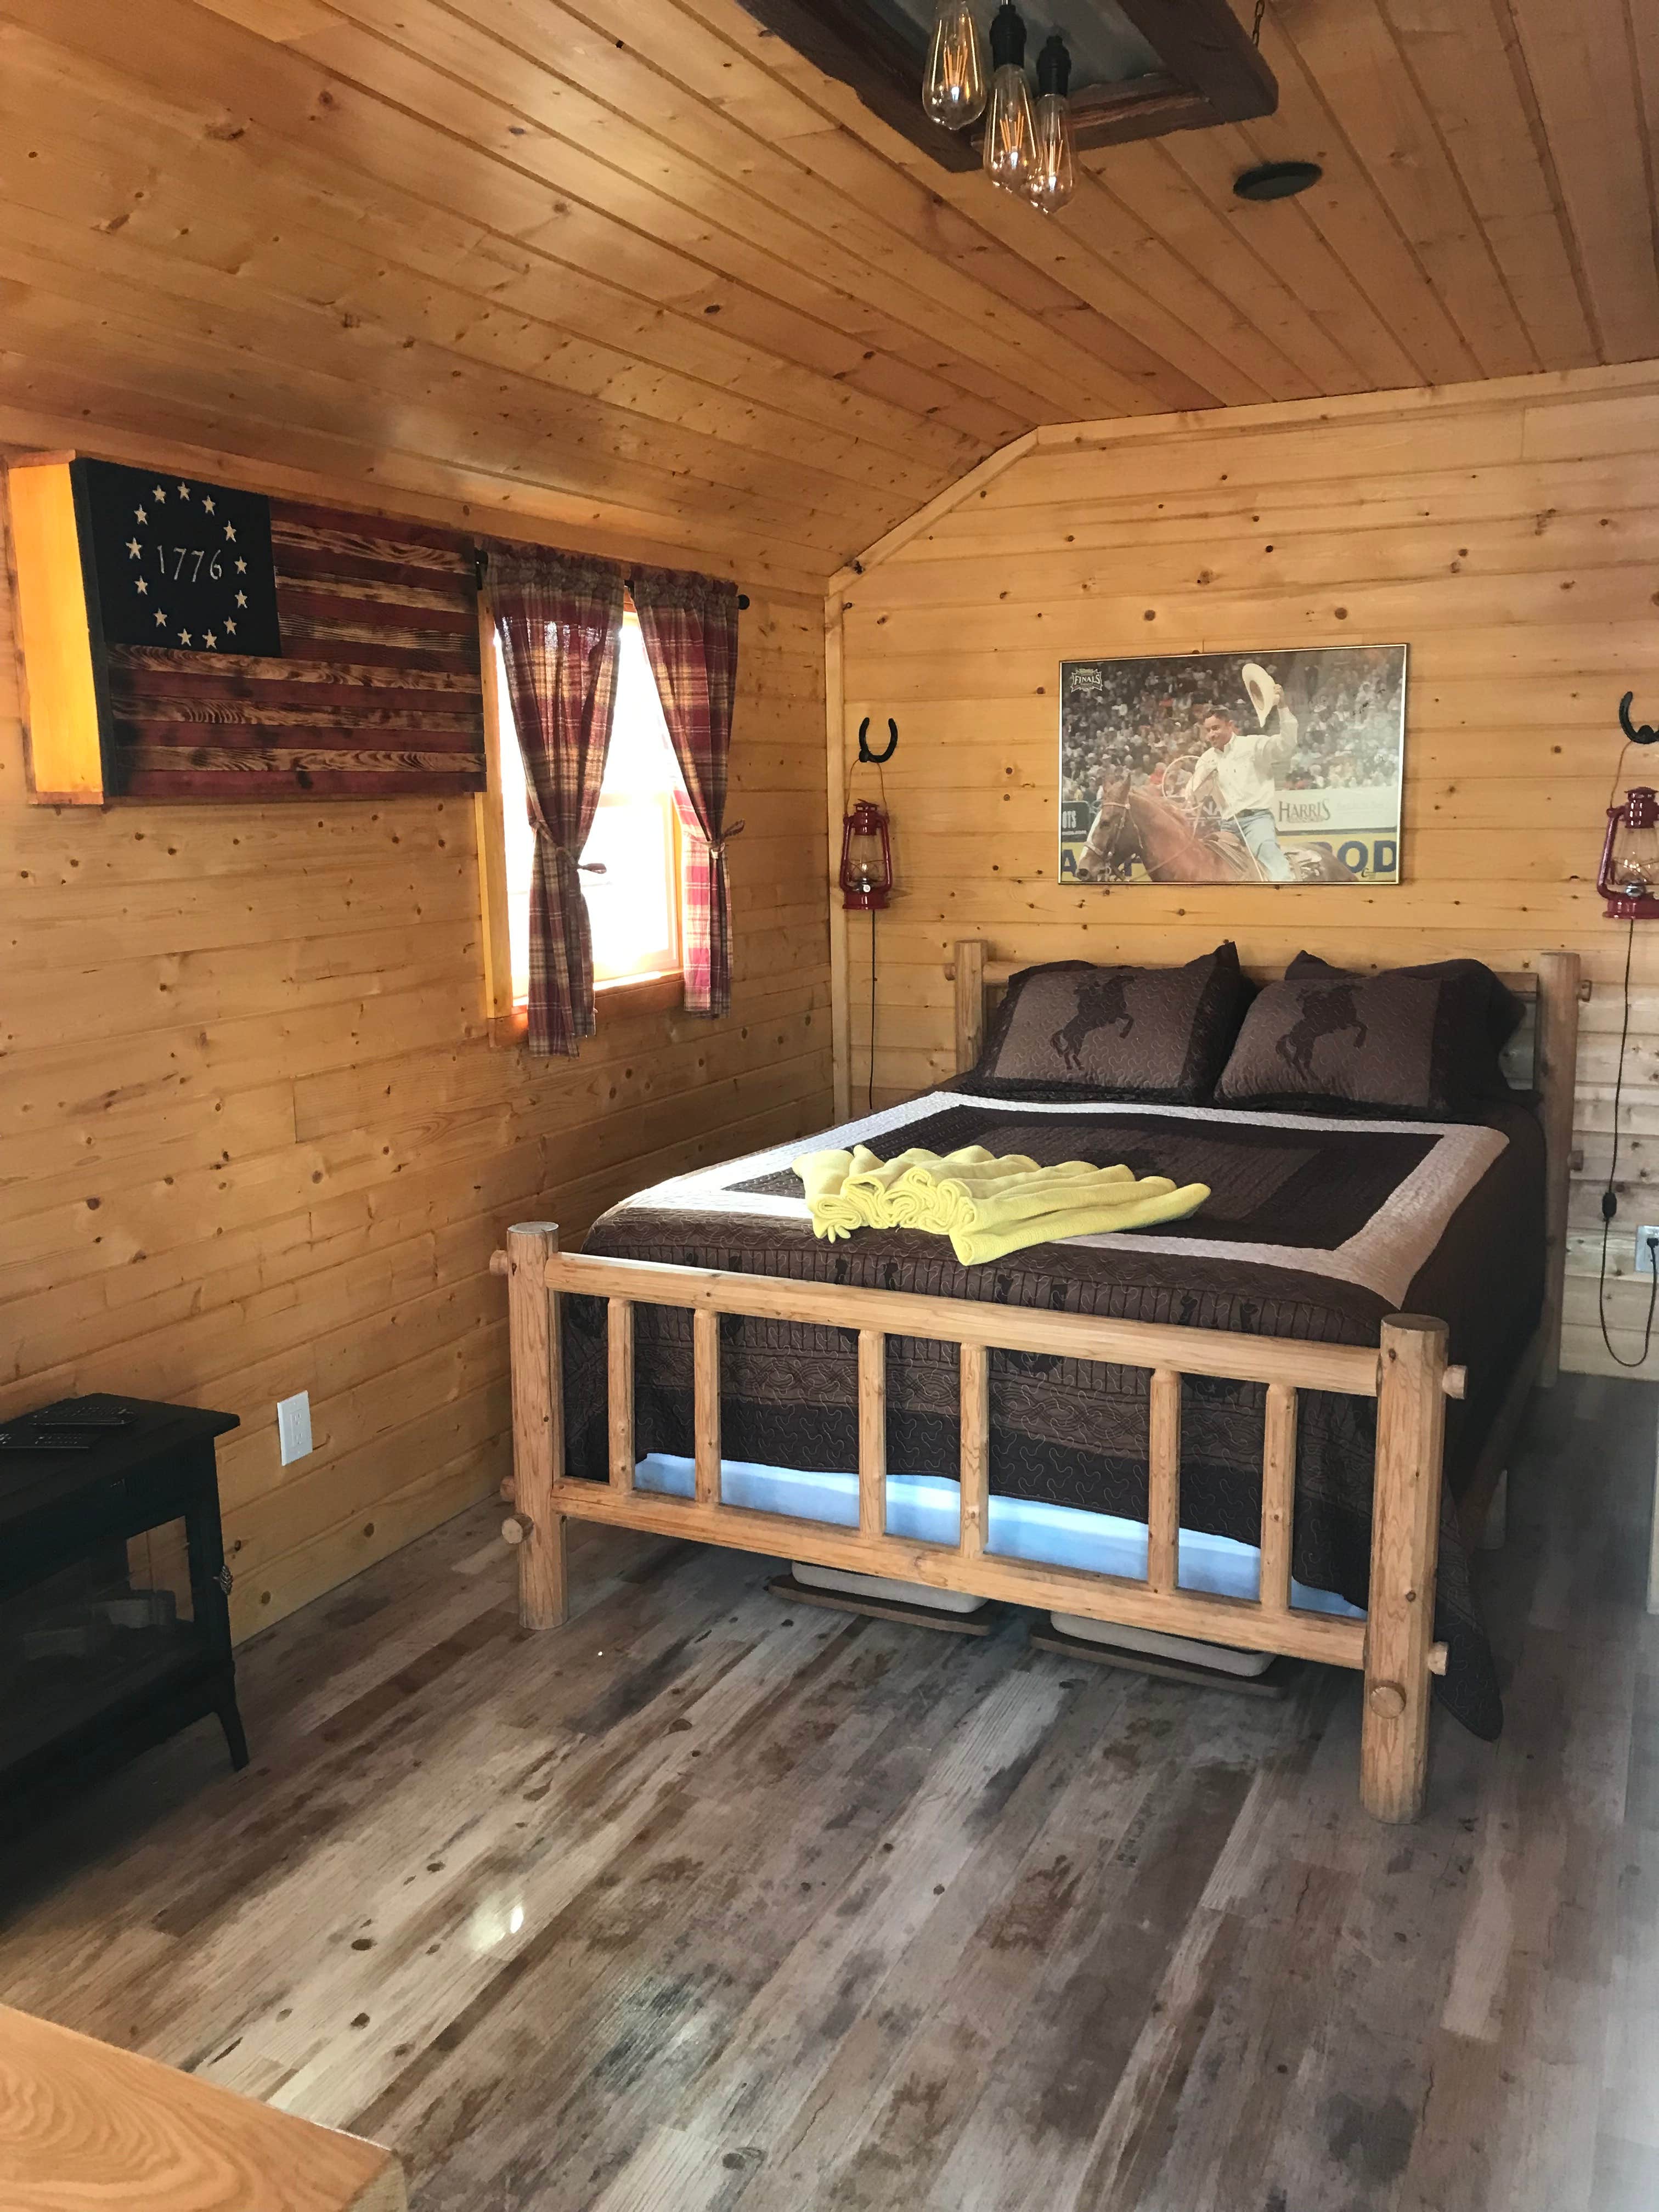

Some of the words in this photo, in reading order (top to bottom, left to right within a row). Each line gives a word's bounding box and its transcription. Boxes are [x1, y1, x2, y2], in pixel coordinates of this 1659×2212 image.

[157, 545, 223, 582] 1776
[1074, 674, 1101, 685] FINALS
[1279, 799, 1331, 822] HARRIS
[1311, 840, 1397, 873] OD
